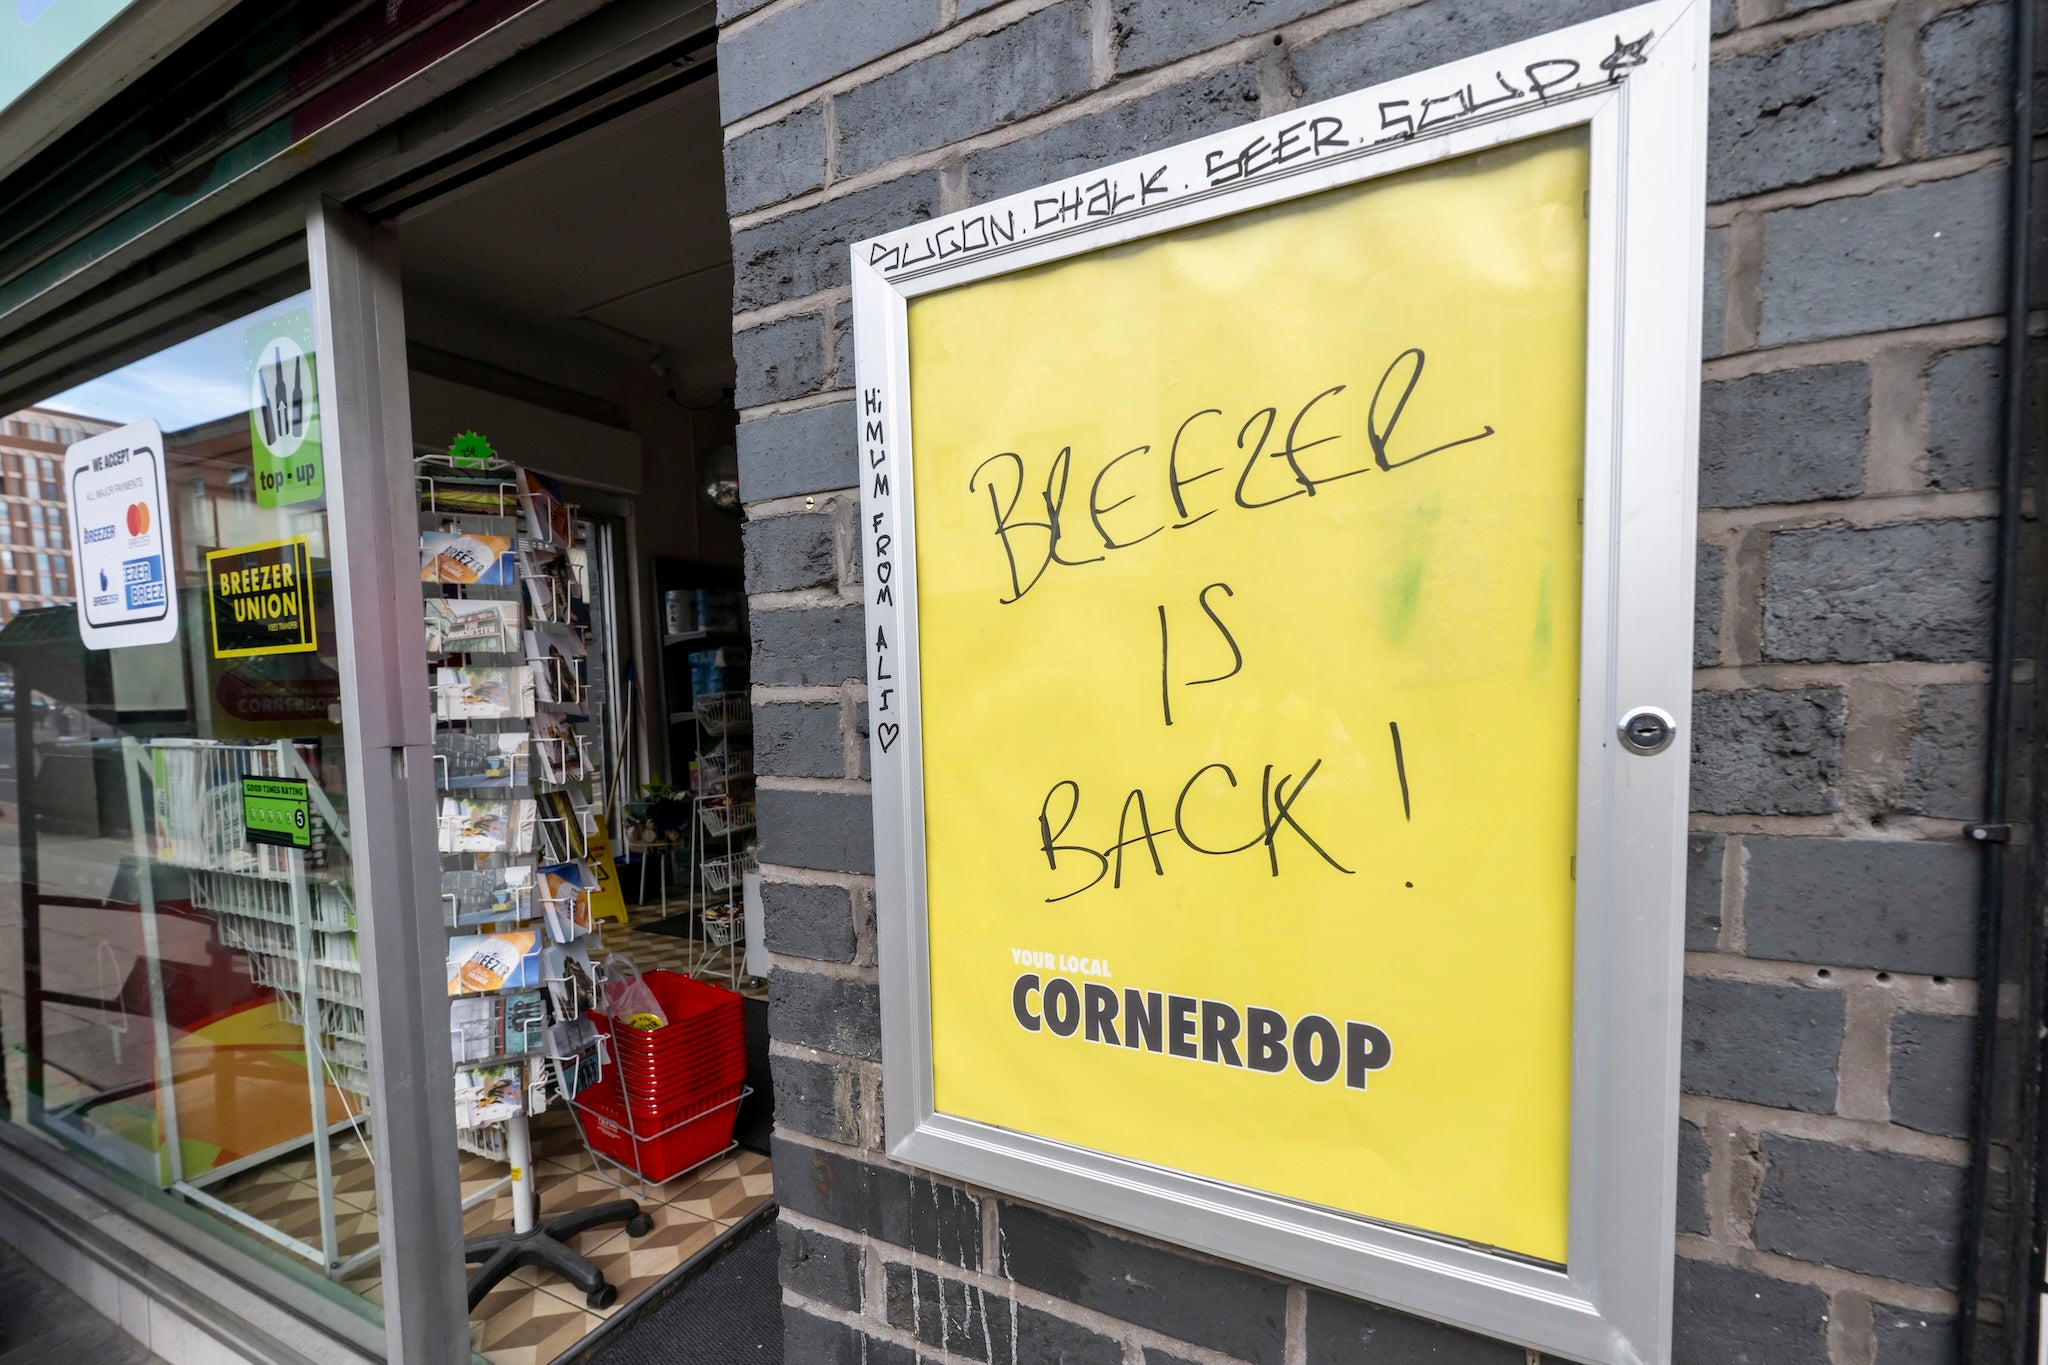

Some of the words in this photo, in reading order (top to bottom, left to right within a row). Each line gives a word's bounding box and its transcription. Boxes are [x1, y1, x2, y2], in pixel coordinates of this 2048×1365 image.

[864, 387, 883, 417] Hi
[92, 457, 104, 473] WE
[104, 448, 130, 469] ACCEPT
[866, 420, 890, 499] MUM
[969, 347, 1496, 605] BREEZER
[220, 562, 294, 597] BREEZER
[872, 512, 893, 607] FROM
[233, 591, 297, 623] UNION
[875, 624, 894, 712] ALI
[1157, 582, 1243, 727] IS
[246, 783, 262, 793] GOOD
[280, 786, 304, 797] RATING
[1011, 948, 1055, 970] YOUR
[1059, 954, 1112, 978] LOCAL
[1012, 973, 1392, 1092] CORNERBOP
